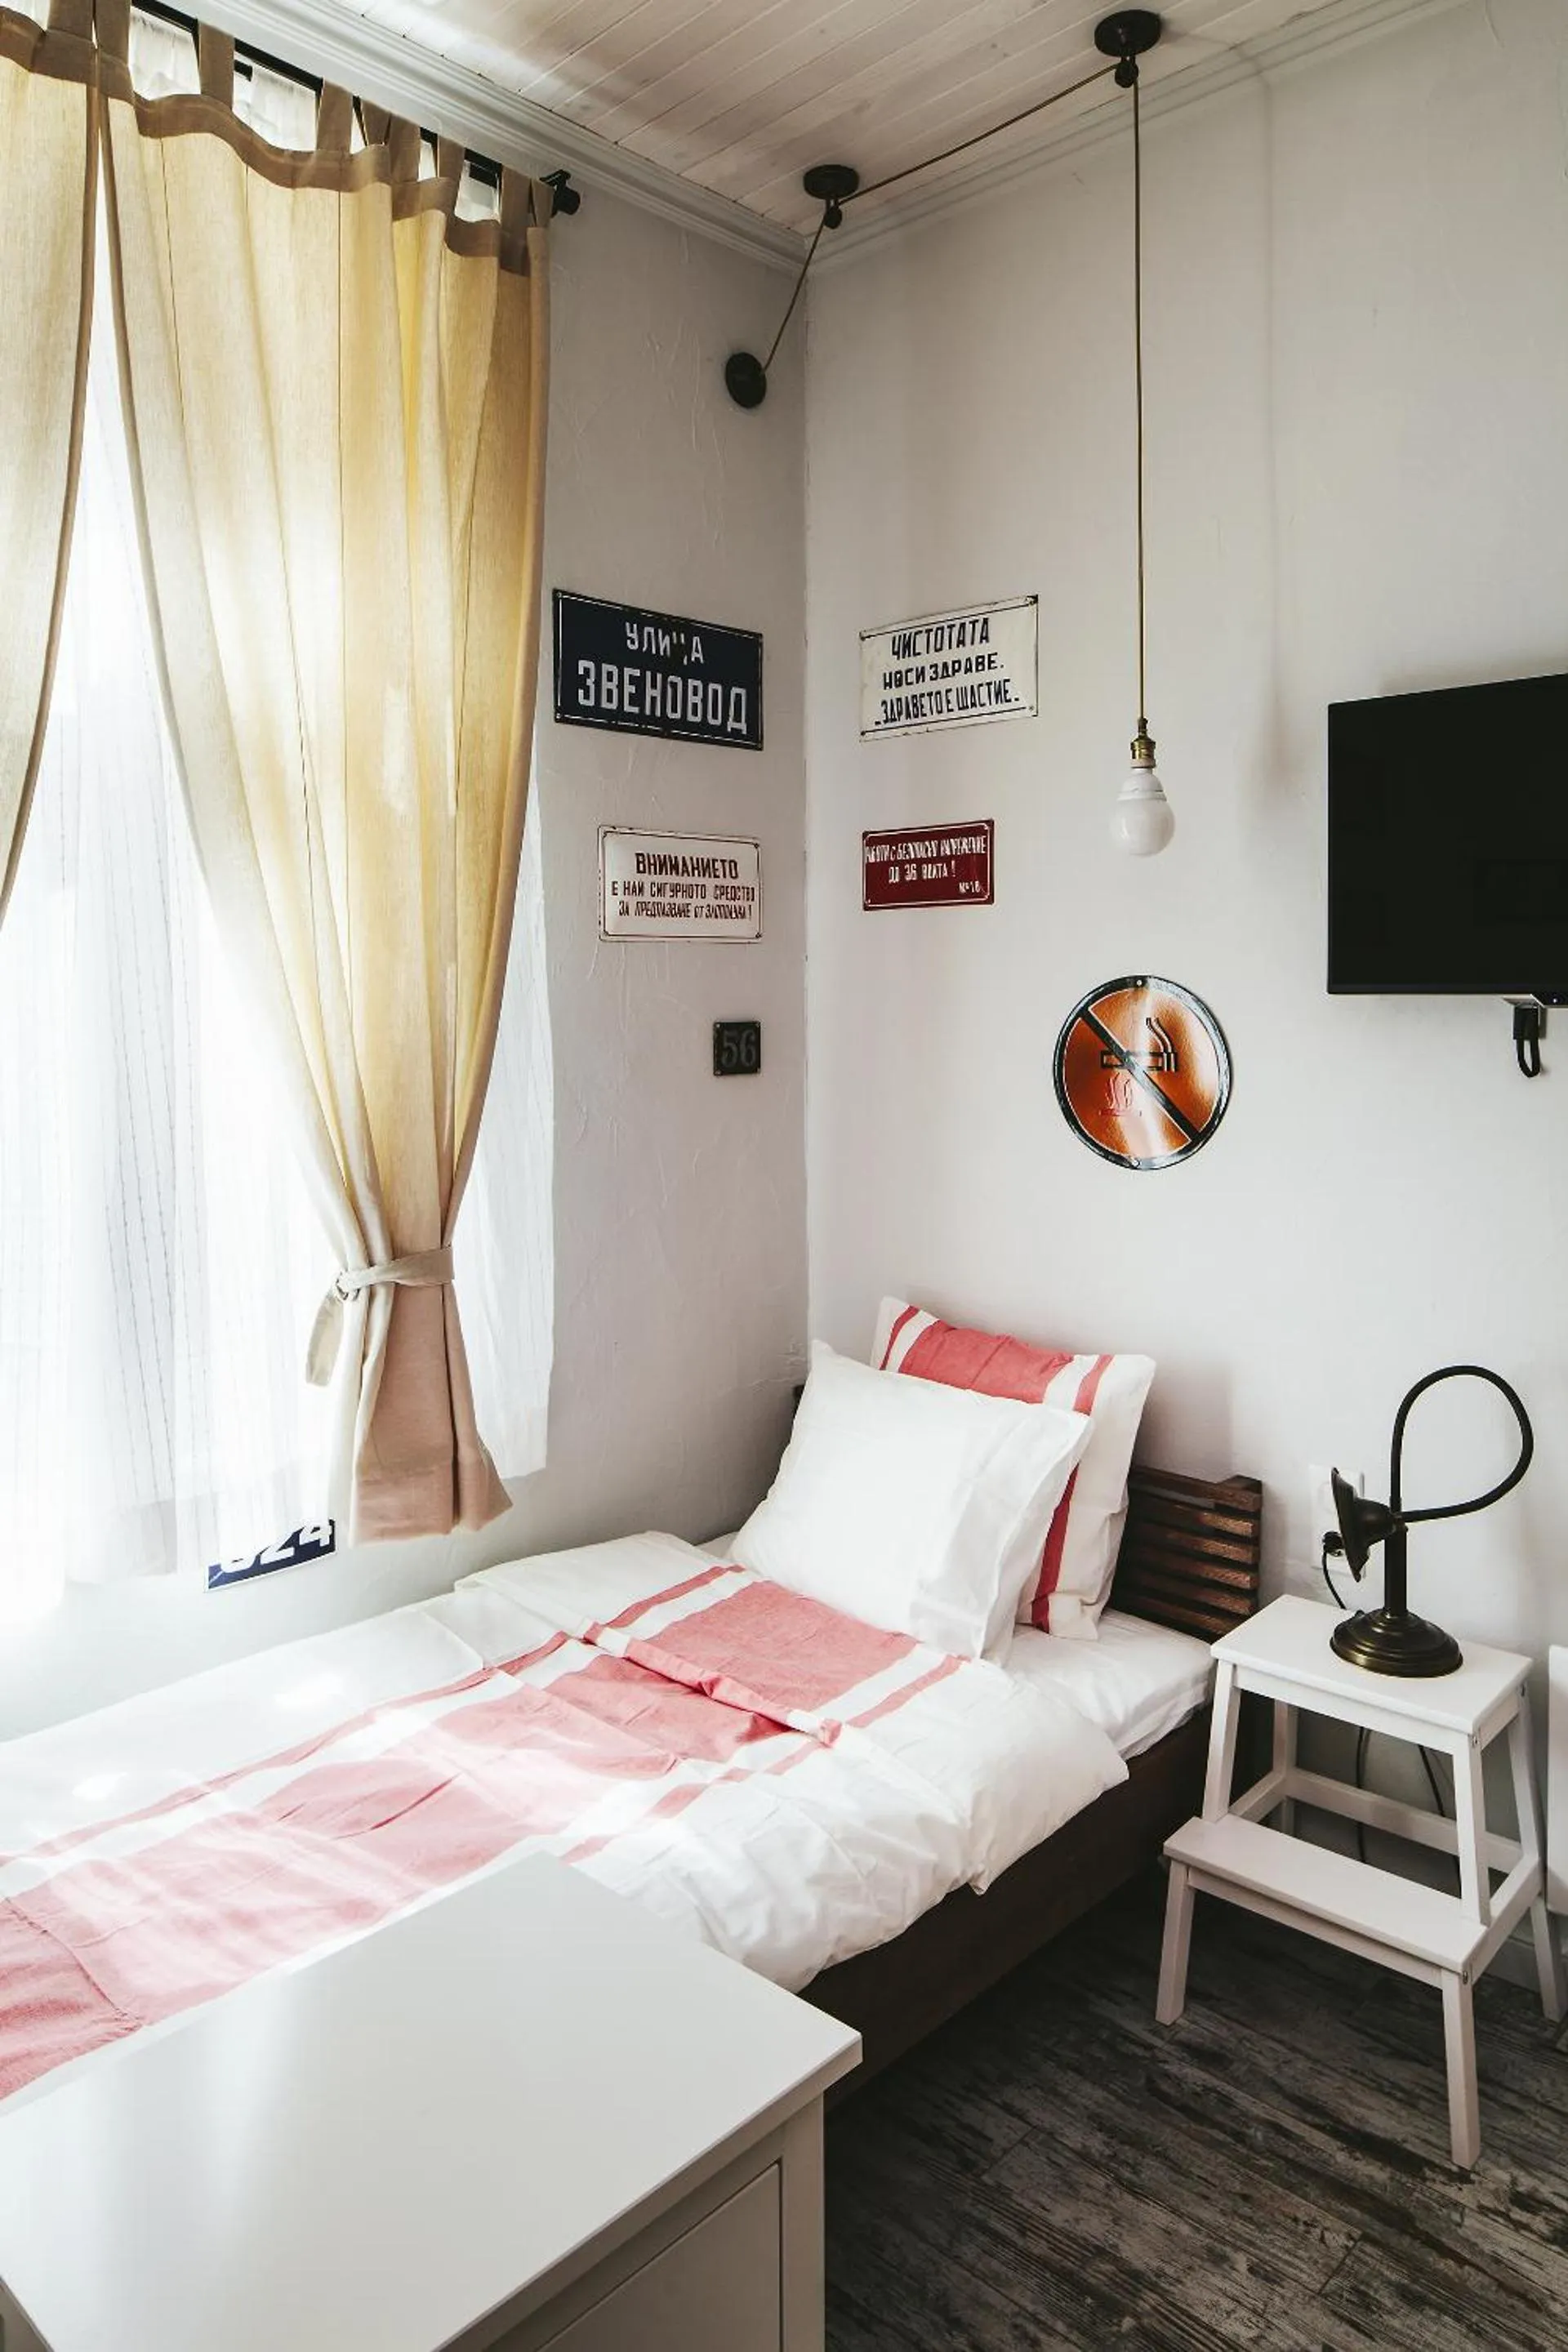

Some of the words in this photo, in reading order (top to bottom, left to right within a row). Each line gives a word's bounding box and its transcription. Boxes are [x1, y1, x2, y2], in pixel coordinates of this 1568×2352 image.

[892, 617, 990, 660] ЧИСТОТАТА
[884, 666, 925, 690] НОСИ
[577, 659, 746, 734] ЗВЕНОВОД
[635, 853, 739, 880] ВНИМАНИЕТО
[612, 881, 618, 896] Е
[650, 882, 706, 899] СИГУРНОТО
[721, 1029, 755, 1067] 56
